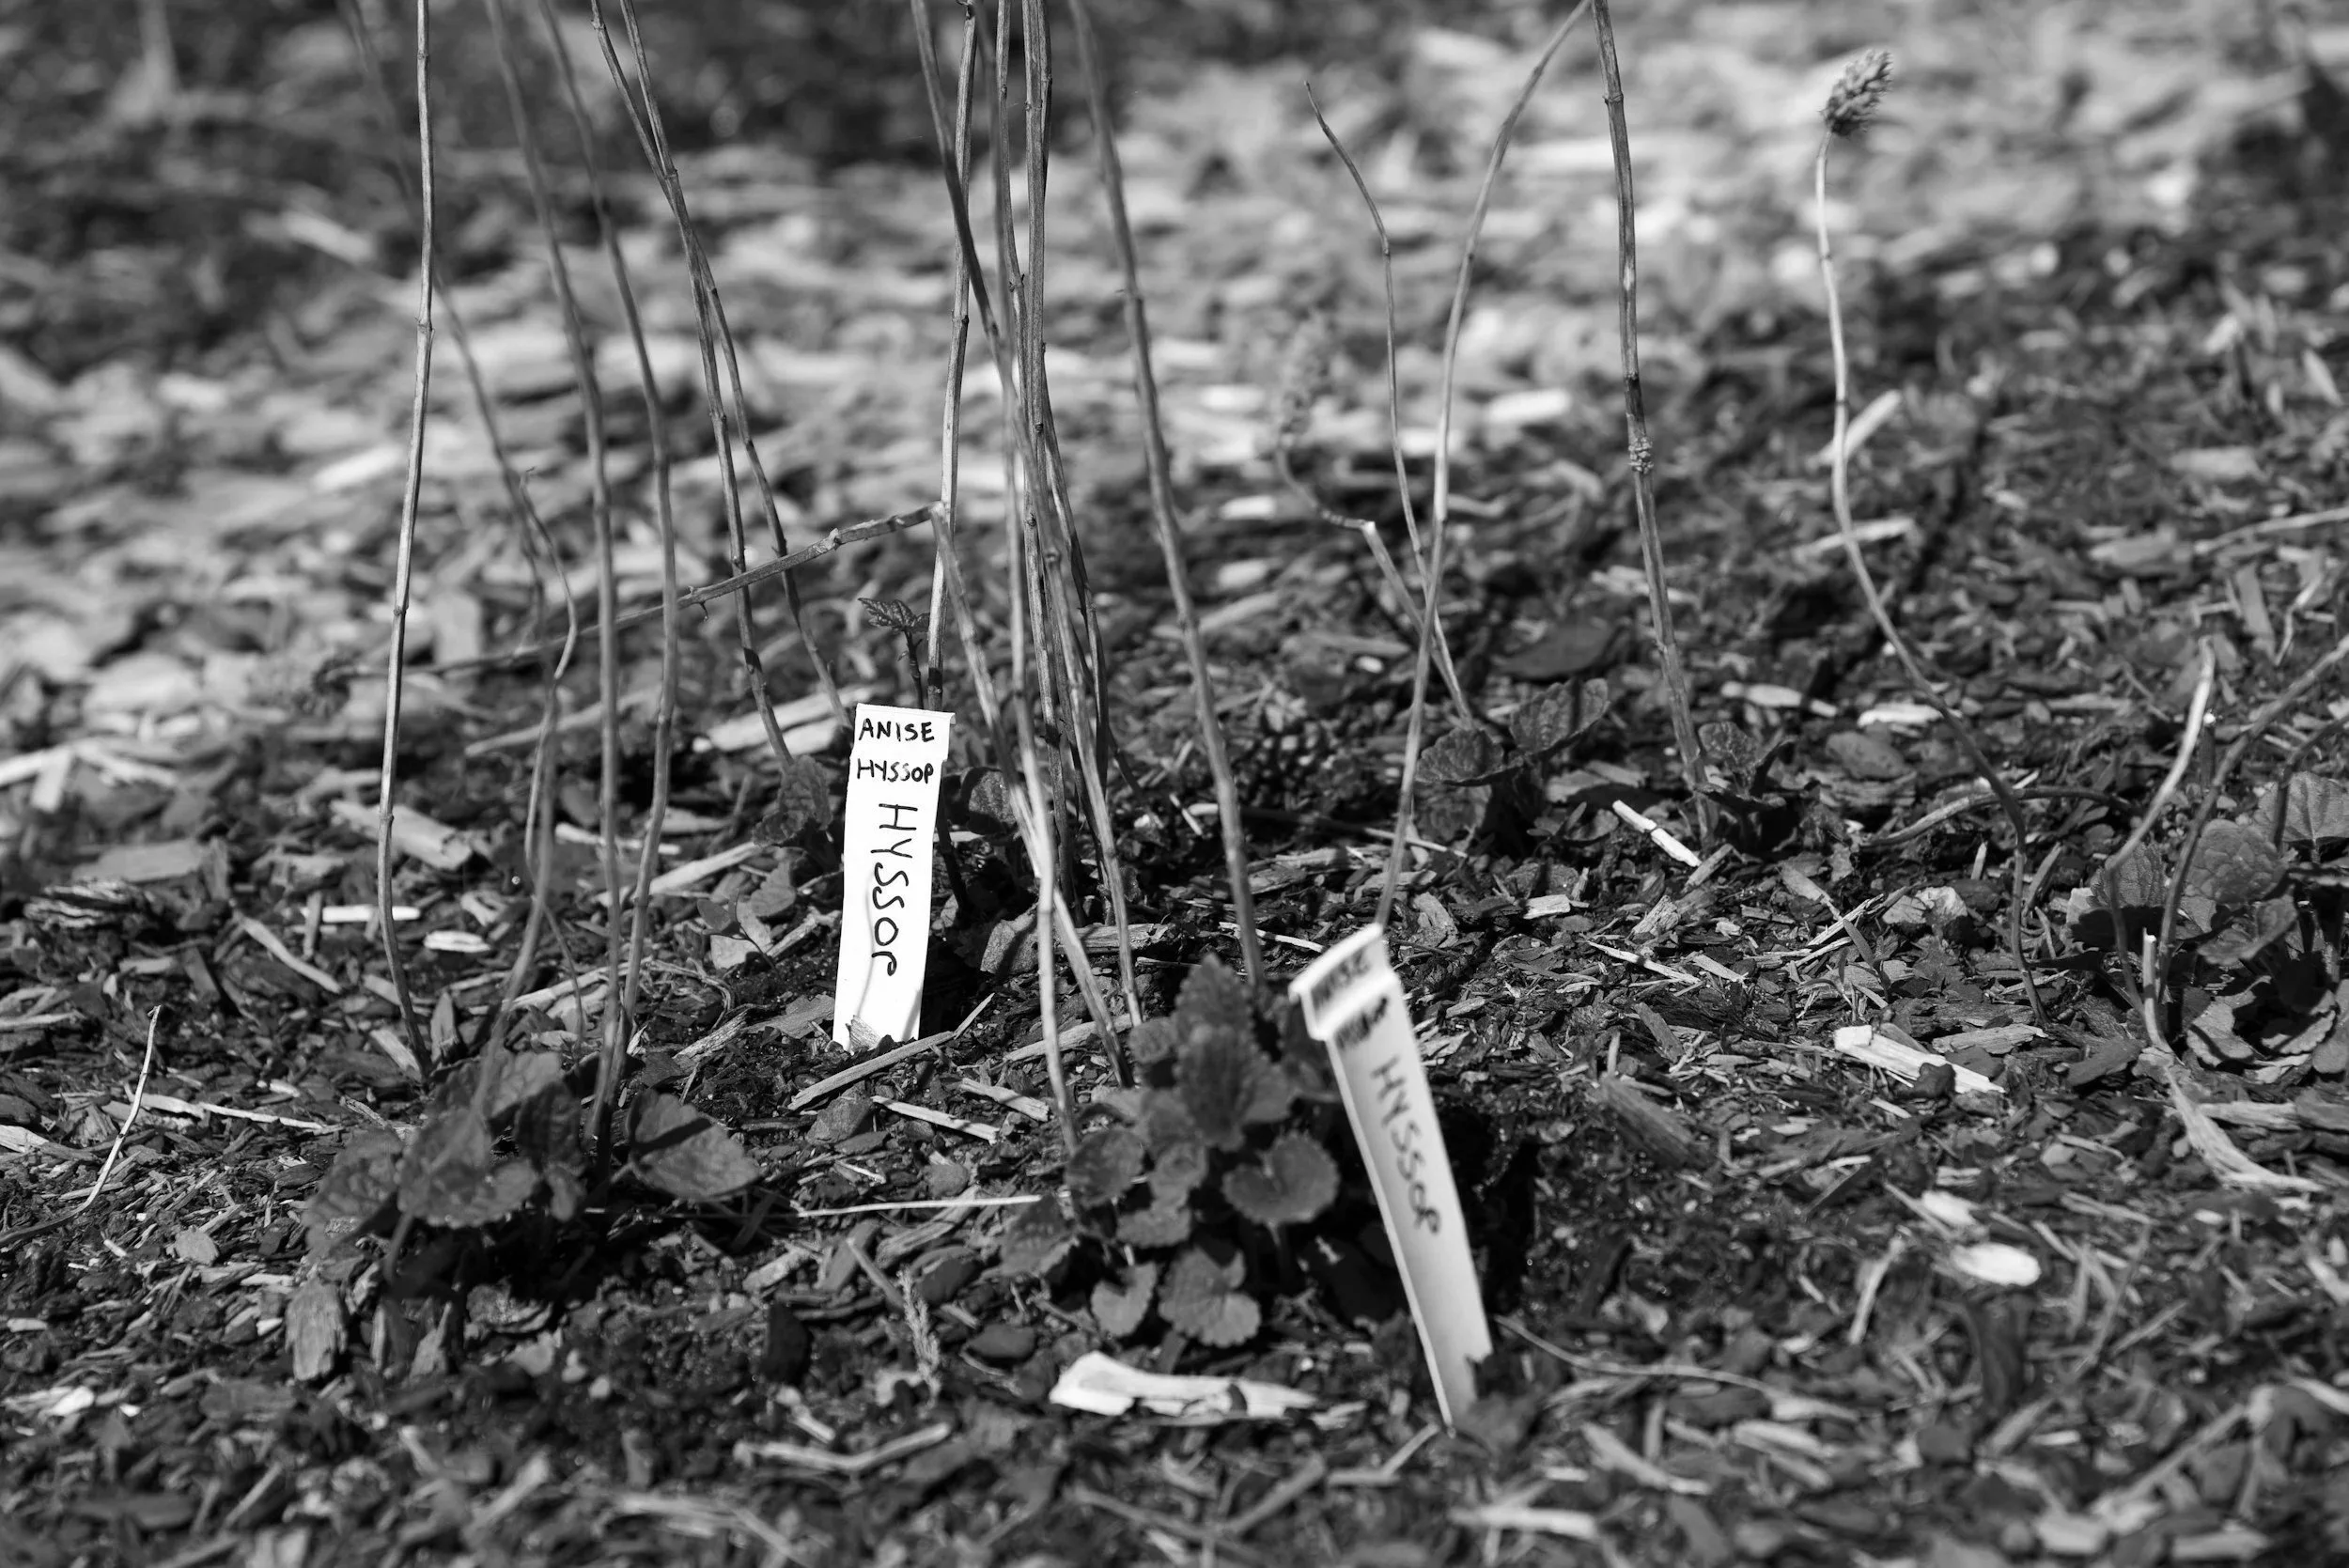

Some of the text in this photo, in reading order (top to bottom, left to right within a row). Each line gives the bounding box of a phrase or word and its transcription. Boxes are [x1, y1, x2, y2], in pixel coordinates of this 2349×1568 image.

[856, 758, 934, 784] HYSSOP
[859, 718, 934, 742] ANISE
[871, 803, 918, 976] HYSSOP
[1371, 1054, 1440, 1234] HYSSOP
